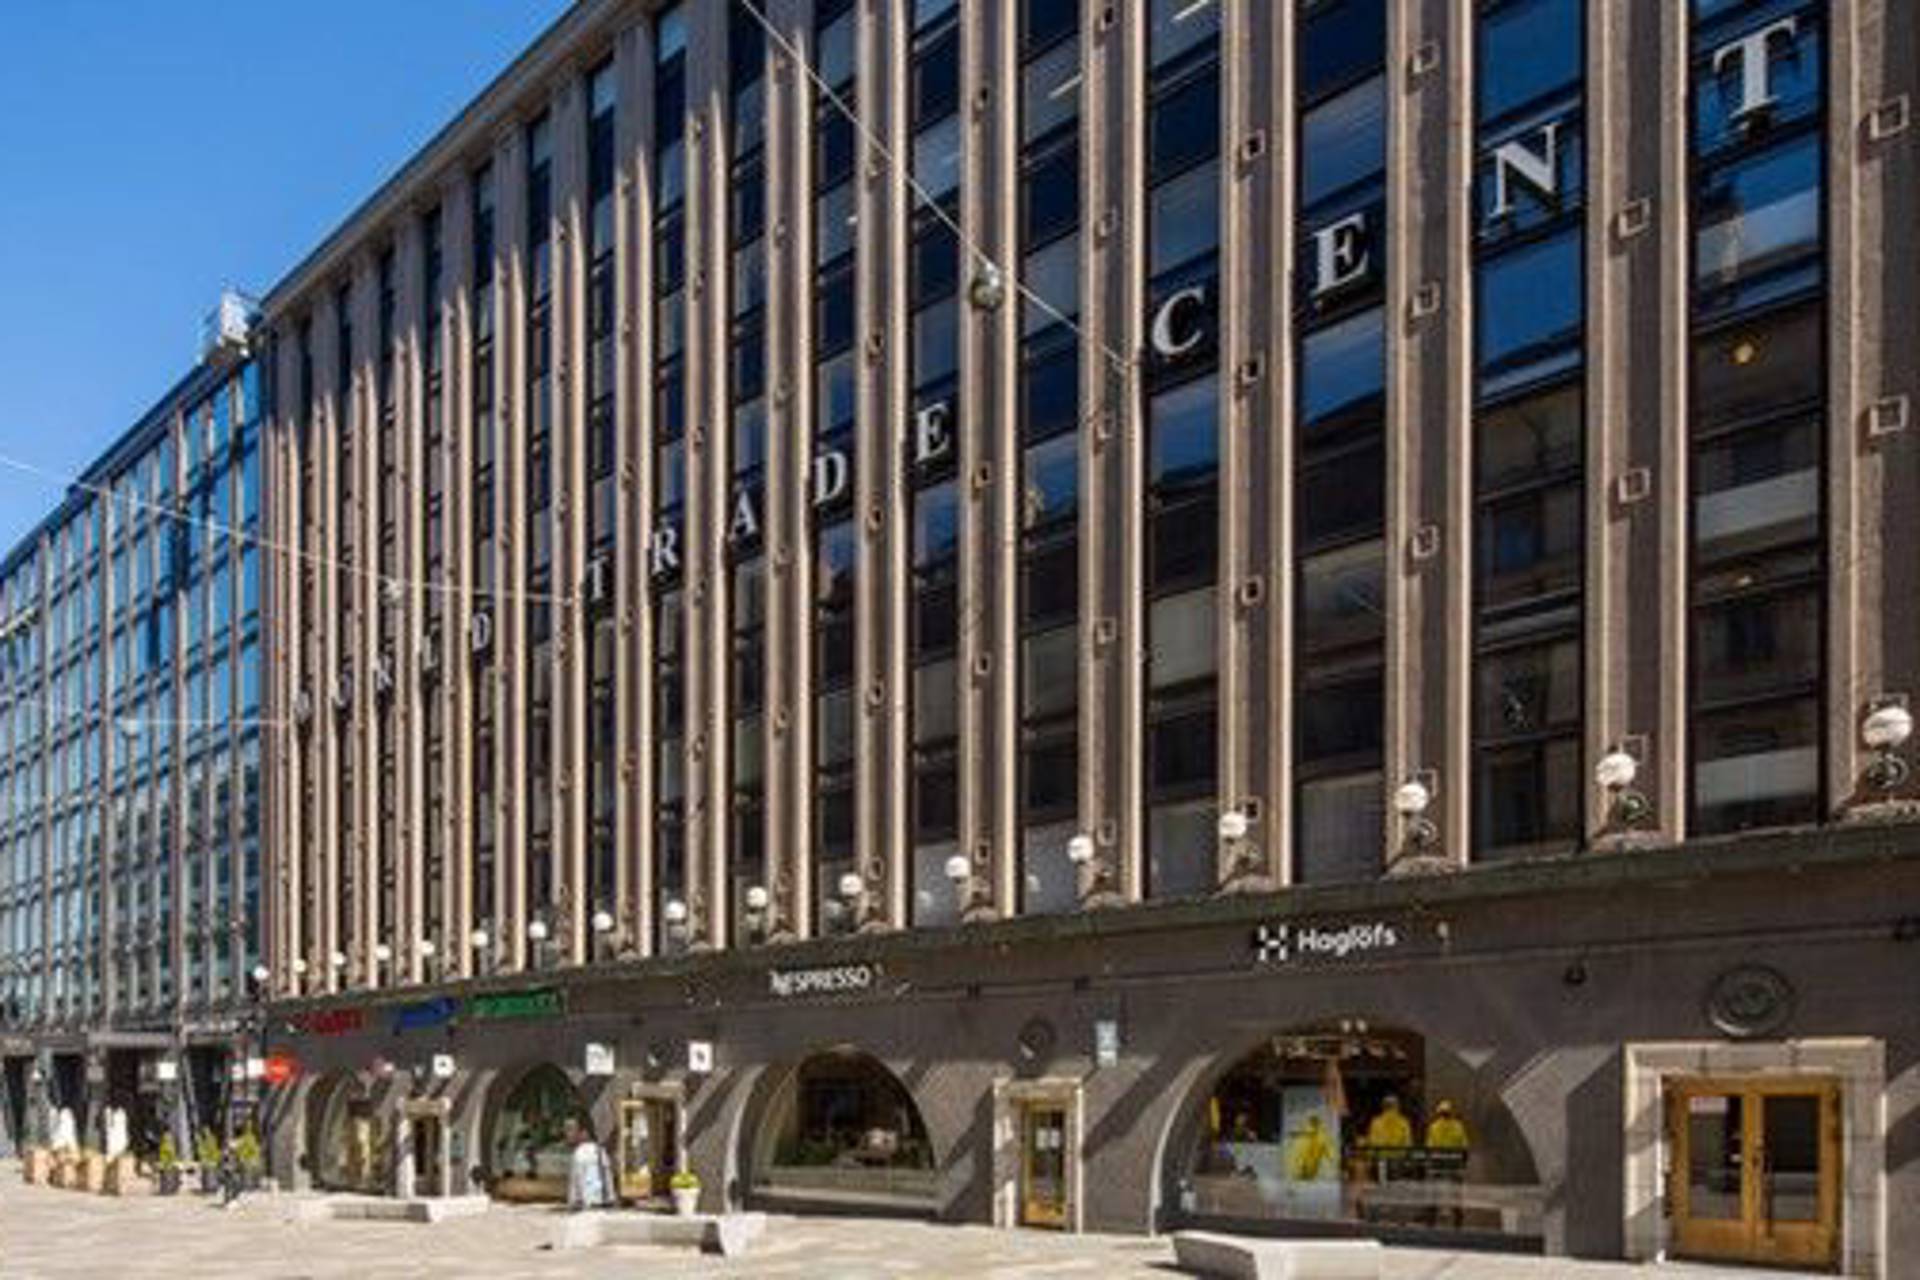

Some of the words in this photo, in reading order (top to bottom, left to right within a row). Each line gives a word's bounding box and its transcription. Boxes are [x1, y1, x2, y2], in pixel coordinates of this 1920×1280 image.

[585, 402, 950, 602] TRADE
[1150, 16, 1798, 358] CENT
[1296, 922, 1398, 957] Haglöfs
[768, 964, 871, 996] NESPRESSO
